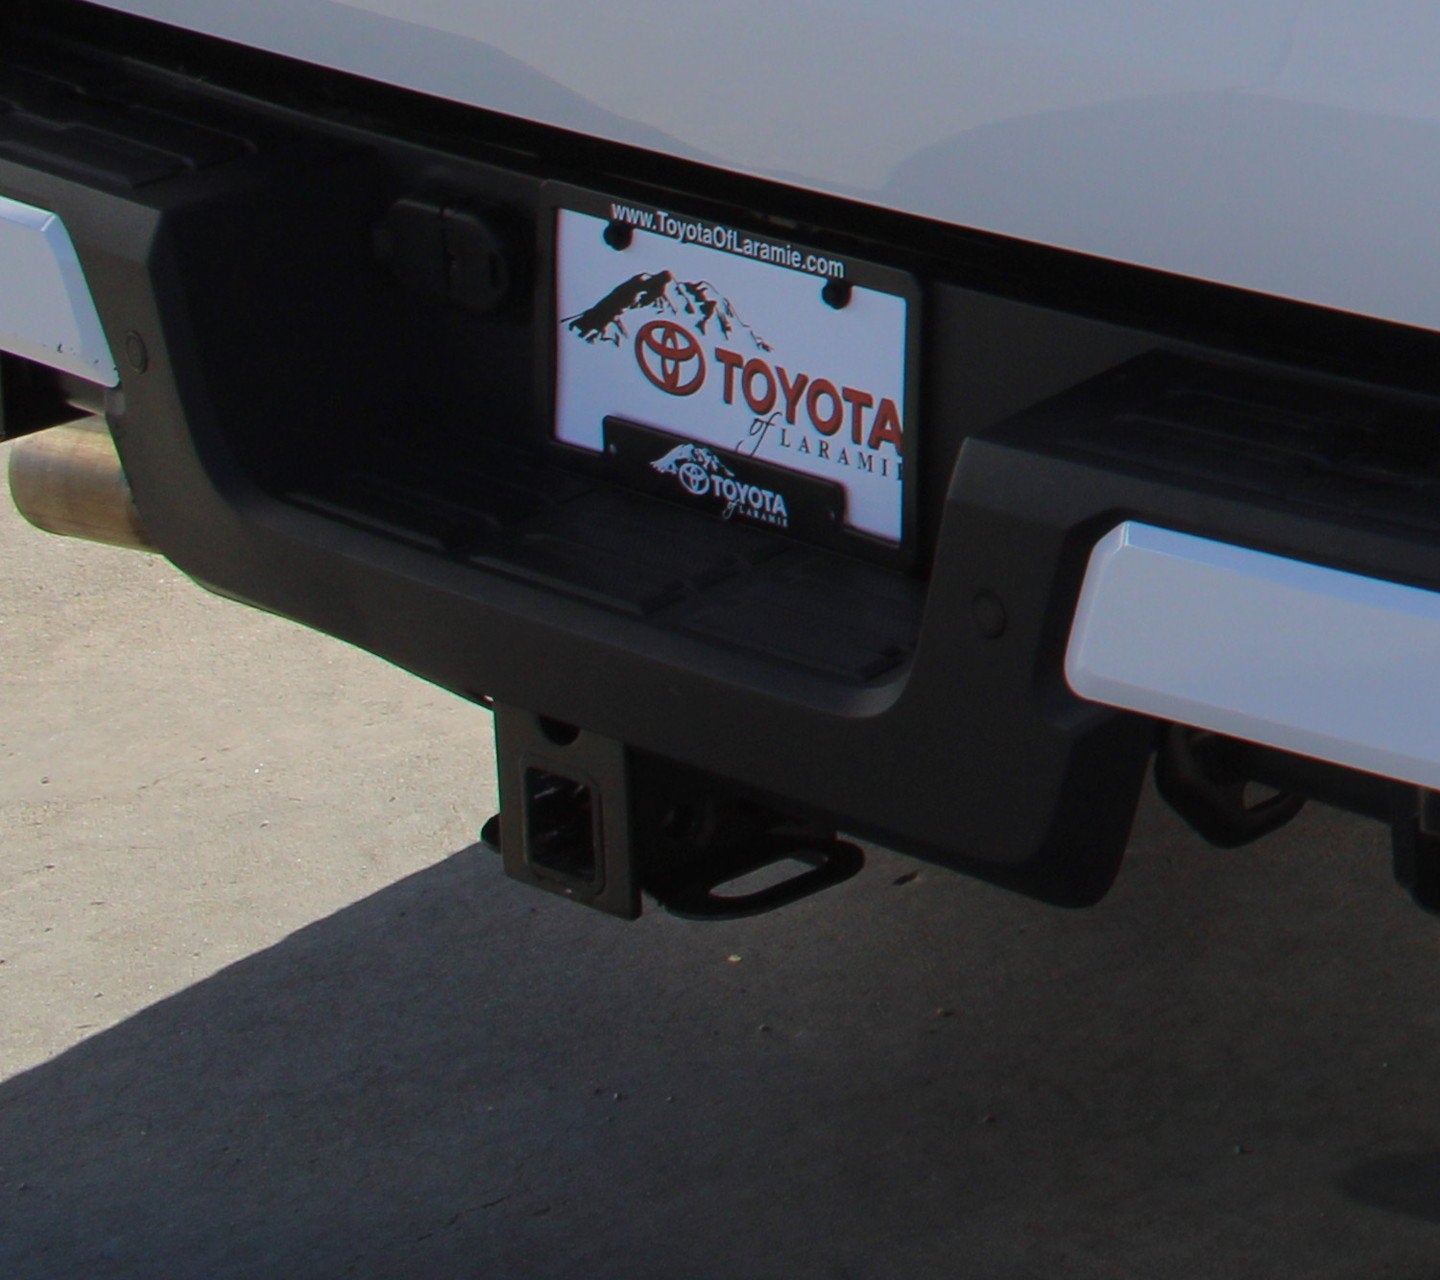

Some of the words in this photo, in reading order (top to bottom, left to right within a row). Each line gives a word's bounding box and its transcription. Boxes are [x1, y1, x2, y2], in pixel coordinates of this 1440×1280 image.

[611, 203, 845, 279] www.ToyotaOfLaramie.com
[714, 347, 903, 457] TOYOTA
[710, 475, 788, 517] TOYOTA
